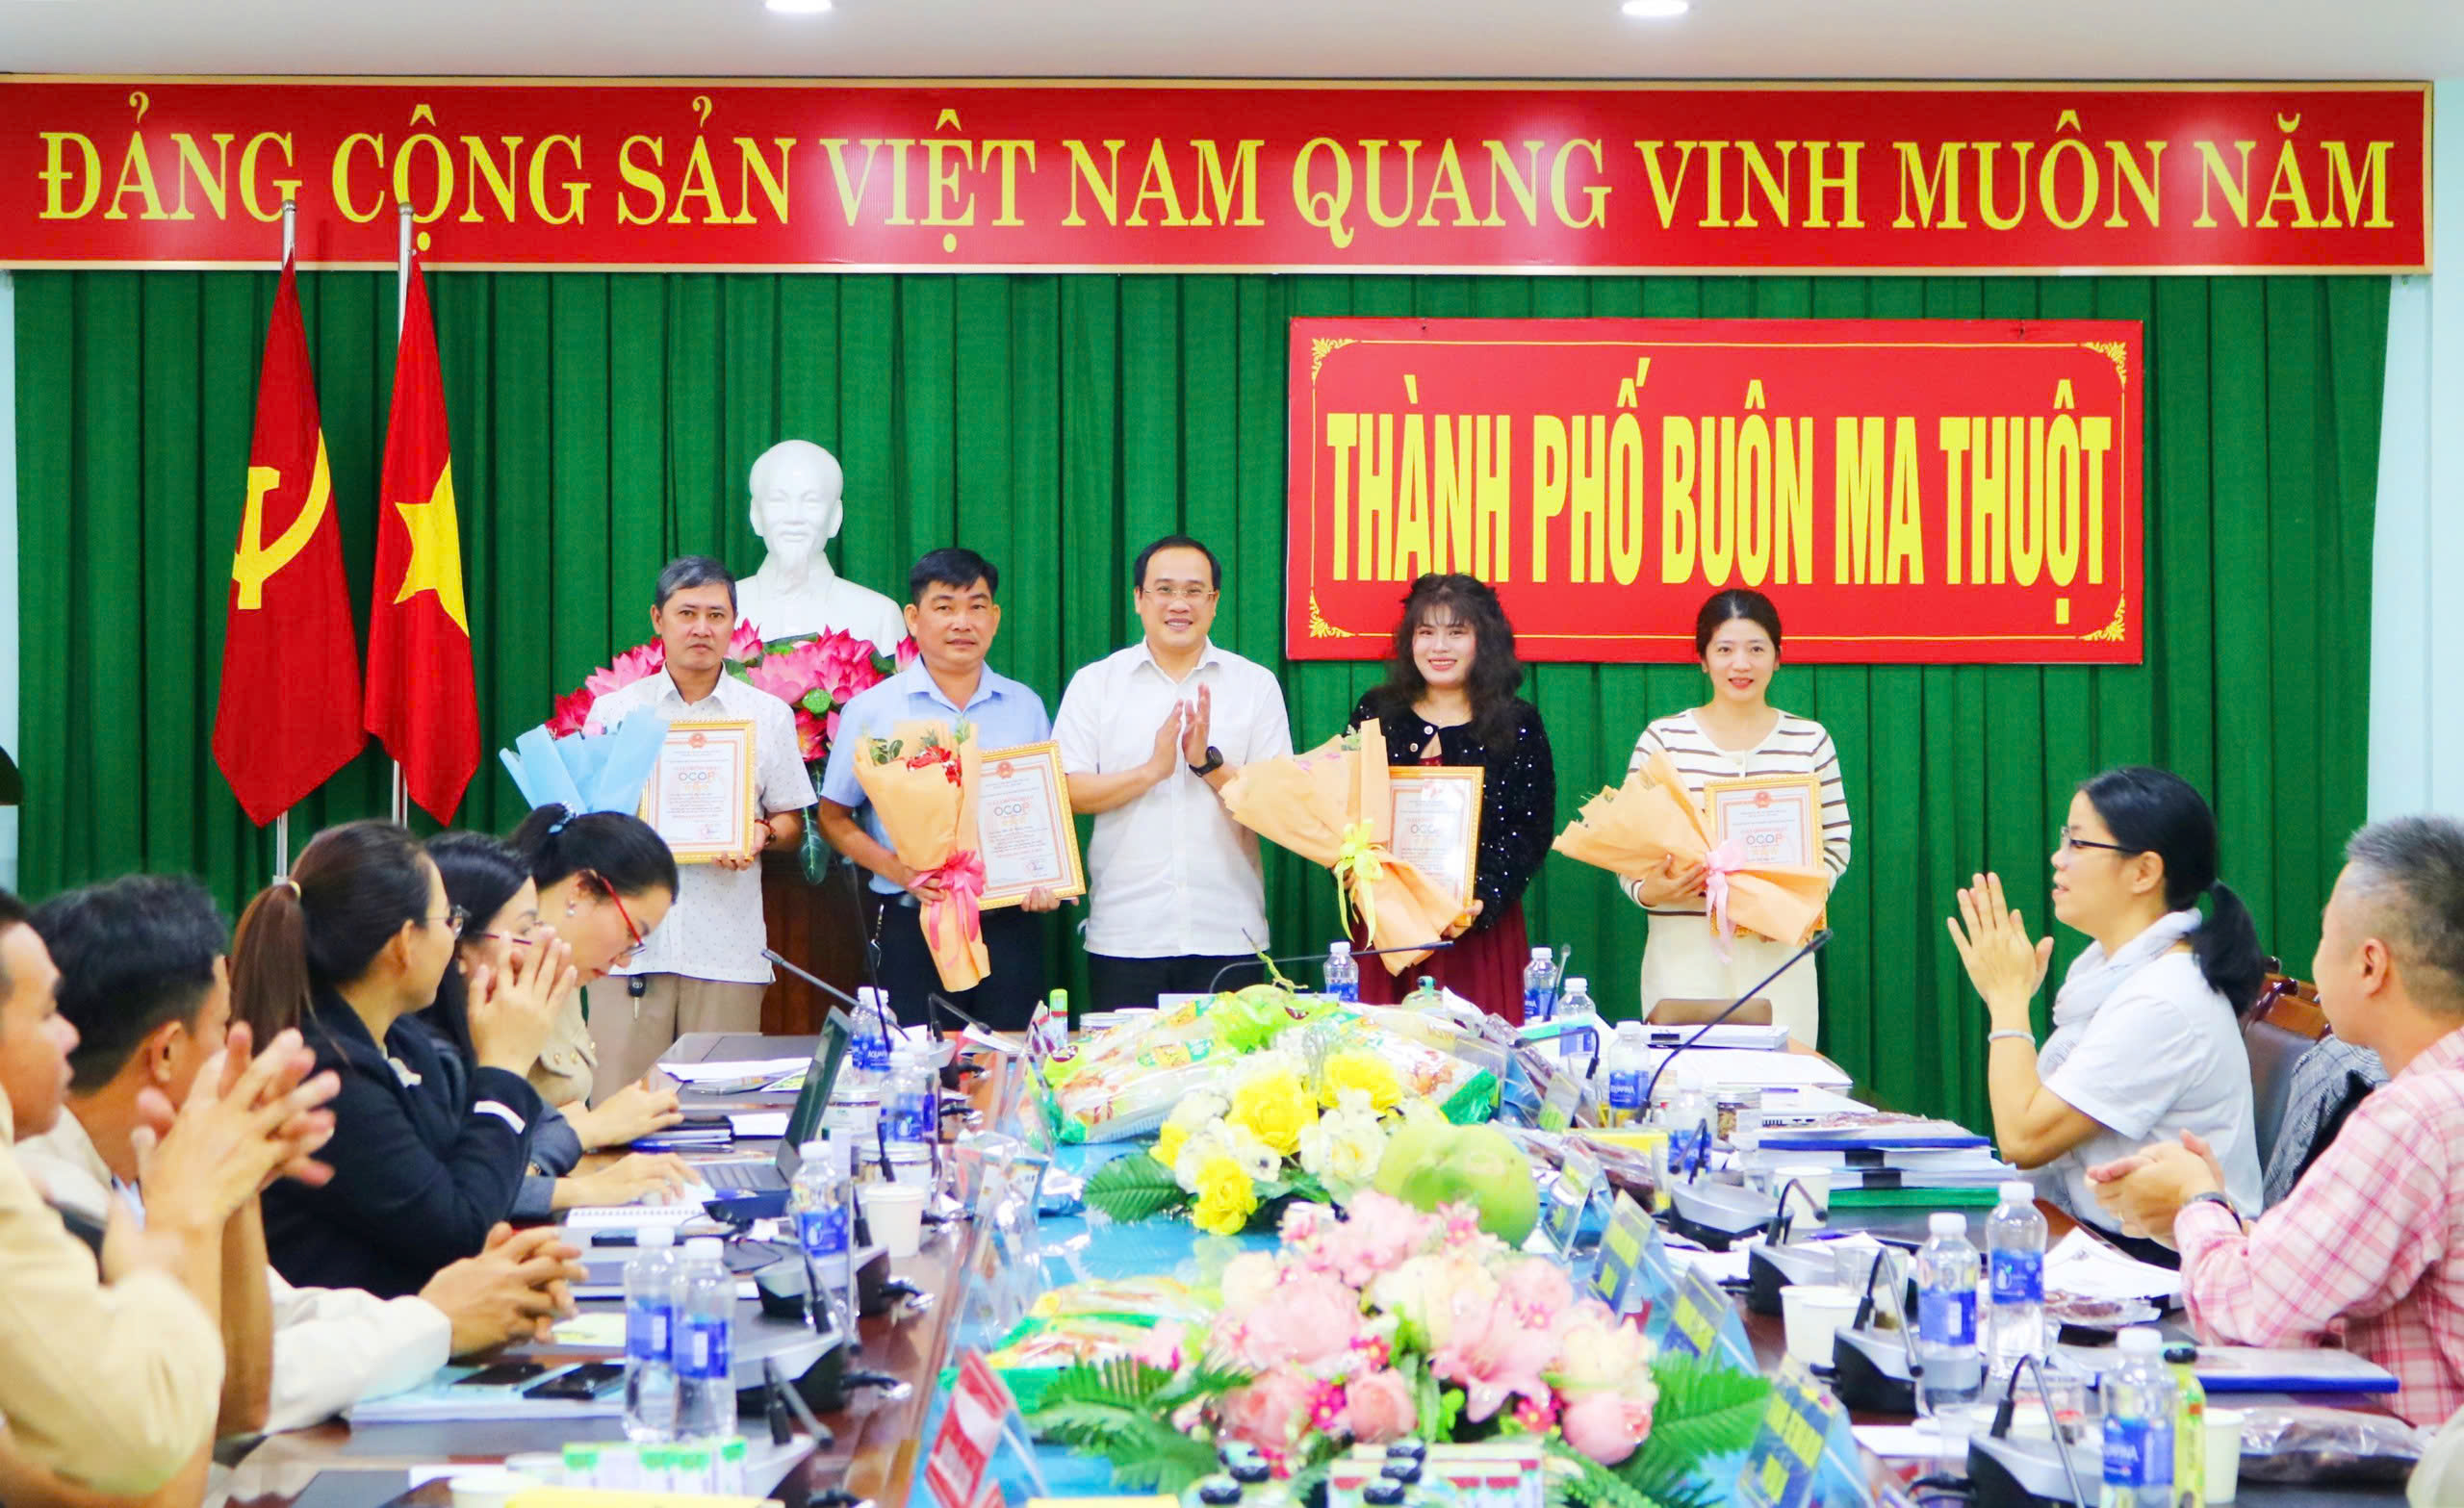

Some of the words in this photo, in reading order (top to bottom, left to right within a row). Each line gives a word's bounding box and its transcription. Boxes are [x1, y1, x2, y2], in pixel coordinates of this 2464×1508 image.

[38, 91, 302, 221] ĐẢNG
[332, 104, 591, 251] CỘNG
[618, 95, 797, 225] SẢN
[820, 109, 1036, 250] VIỆT
[1062, 139, 1264, 228] NAM
[1293, 137, 1612, 249] QUANG
[1634, 141, 1864, 228] VINH
[1892, 110, 2168, 231] MUÔN
[2194, 115, 2395, 229] NĂM
[1326, 373, 1511, 583] THÀNH
[1531, 356, 1652, 586] PHỐ
[1661, 378, 1814, 587] BUÔN
[1835, 416, 1925, 585] MA
[1939, 378, 2112, 625] THUỘT
